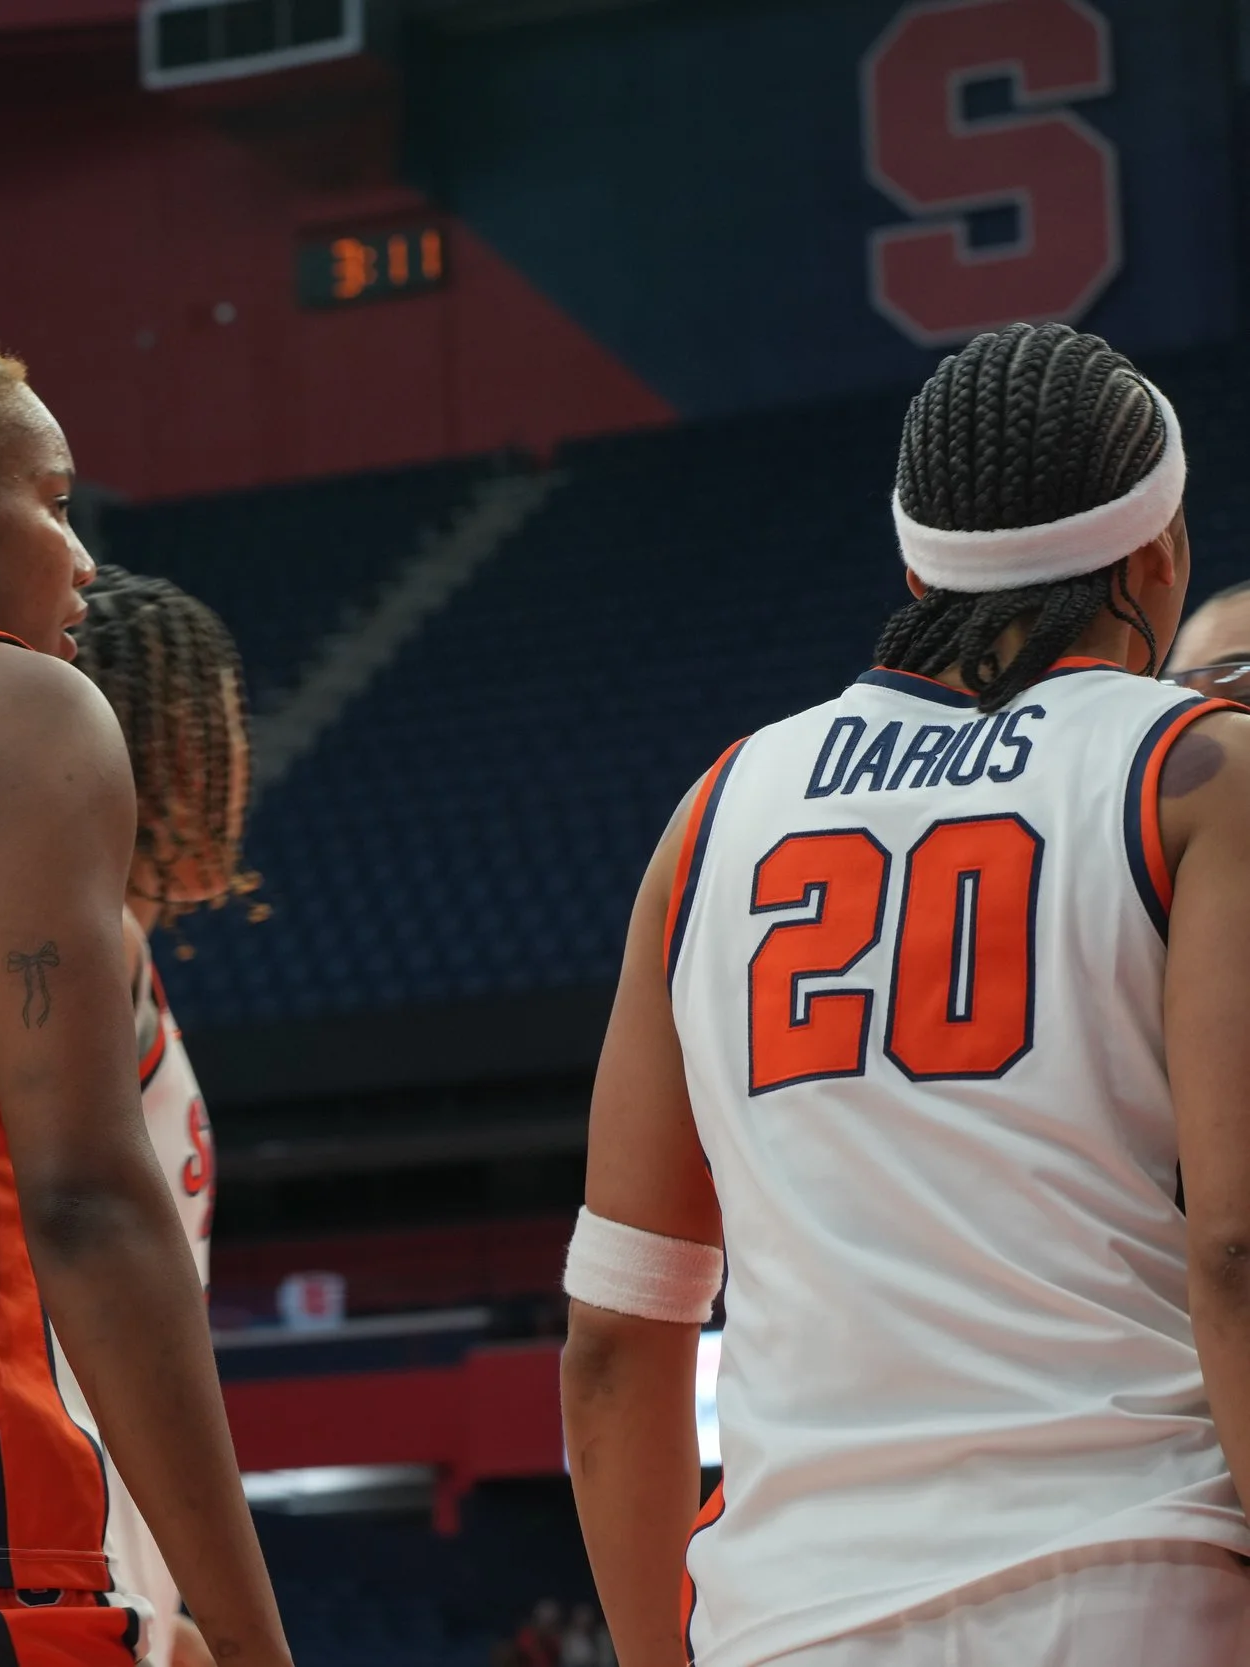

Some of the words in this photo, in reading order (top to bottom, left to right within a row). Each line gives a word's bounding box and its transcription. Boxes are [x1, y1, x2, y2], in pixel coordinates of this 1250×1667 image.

[330, 229, 442, 298] 3:11
[860, 0, 1121, 348] S
[804, 704, 1046, 799] DARIUS
[748, 812, 1045, 1097] 20
